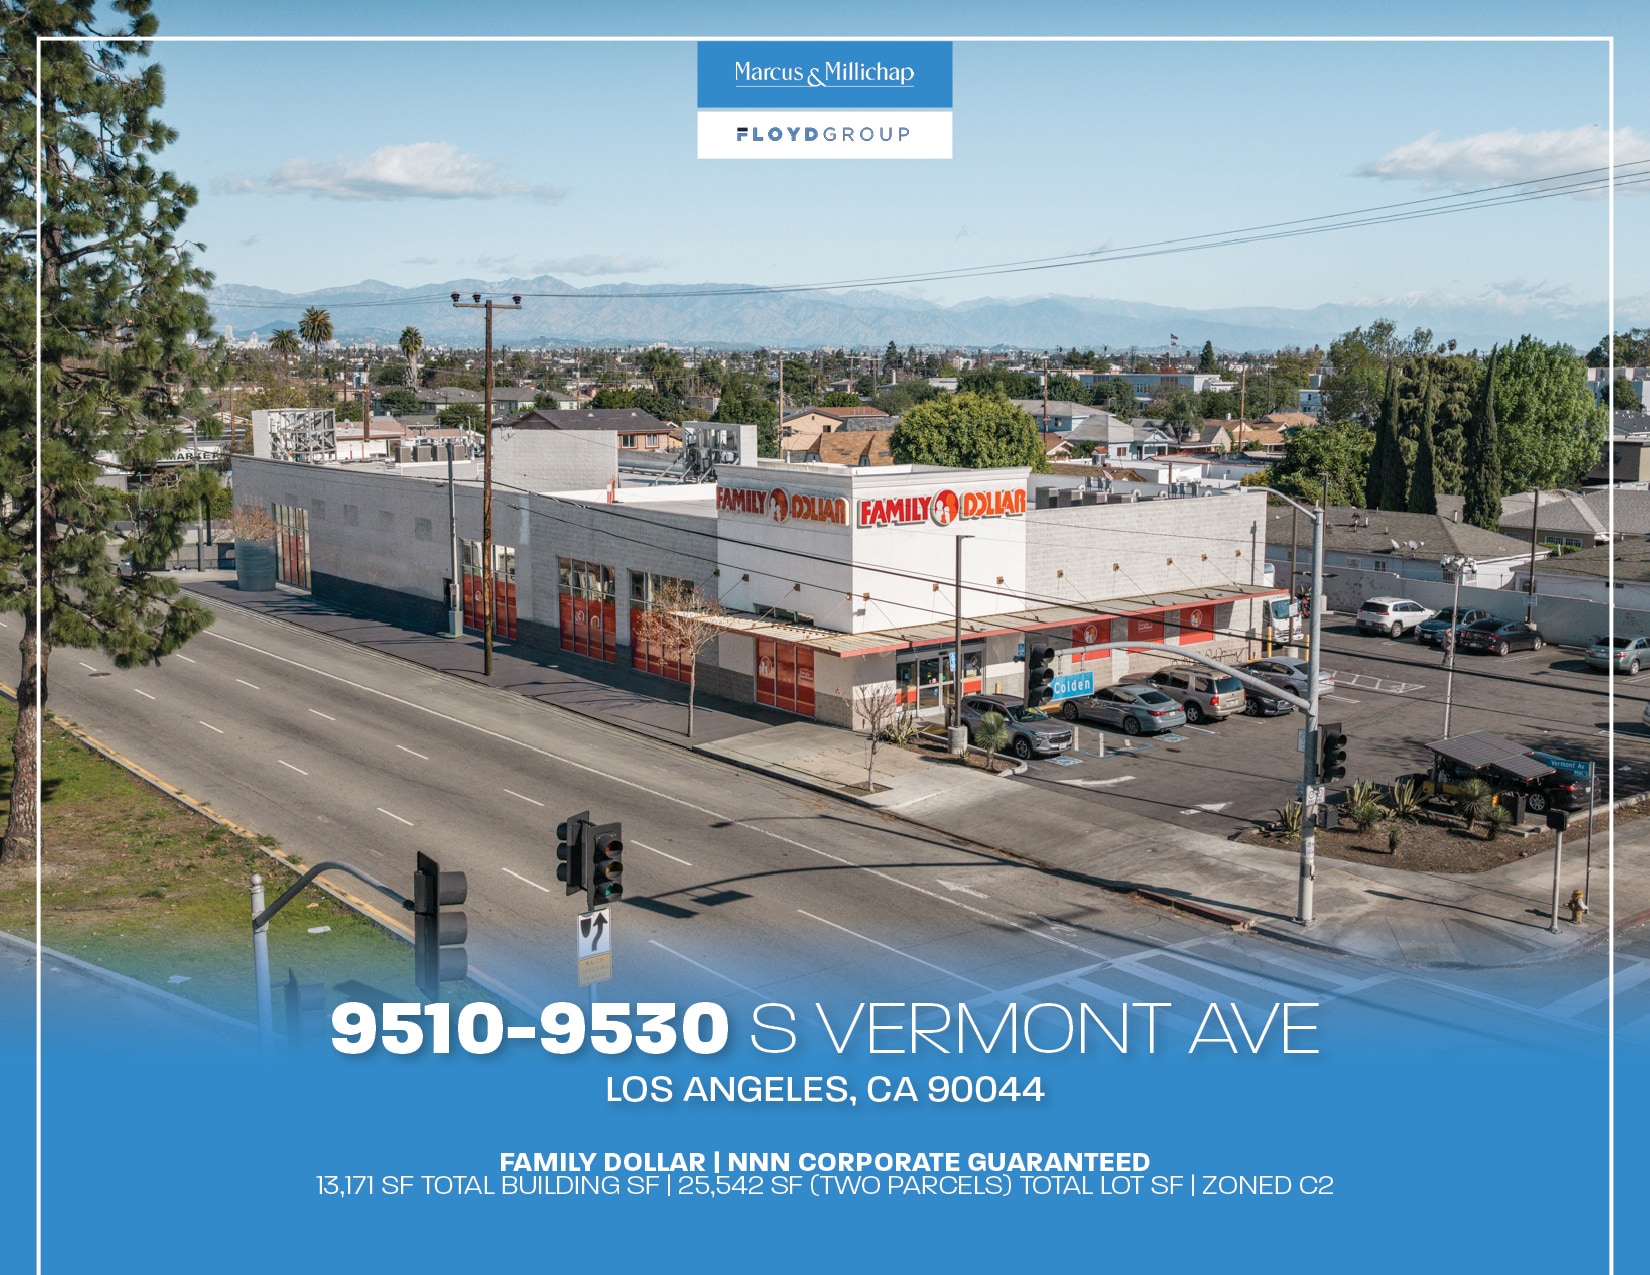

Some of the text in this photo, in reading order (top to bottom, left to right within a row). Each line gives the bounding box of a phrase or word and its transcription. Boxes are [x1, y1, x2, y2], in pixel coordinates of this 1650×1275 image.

[716, 486, 847, 525] FAMILY DOLLAR
[860, 488, 1027, 526] FAMILY DOLLAR
[1053, 679, 1091, 695] Colden
[1550, 760, 1576, 769] Vermont
